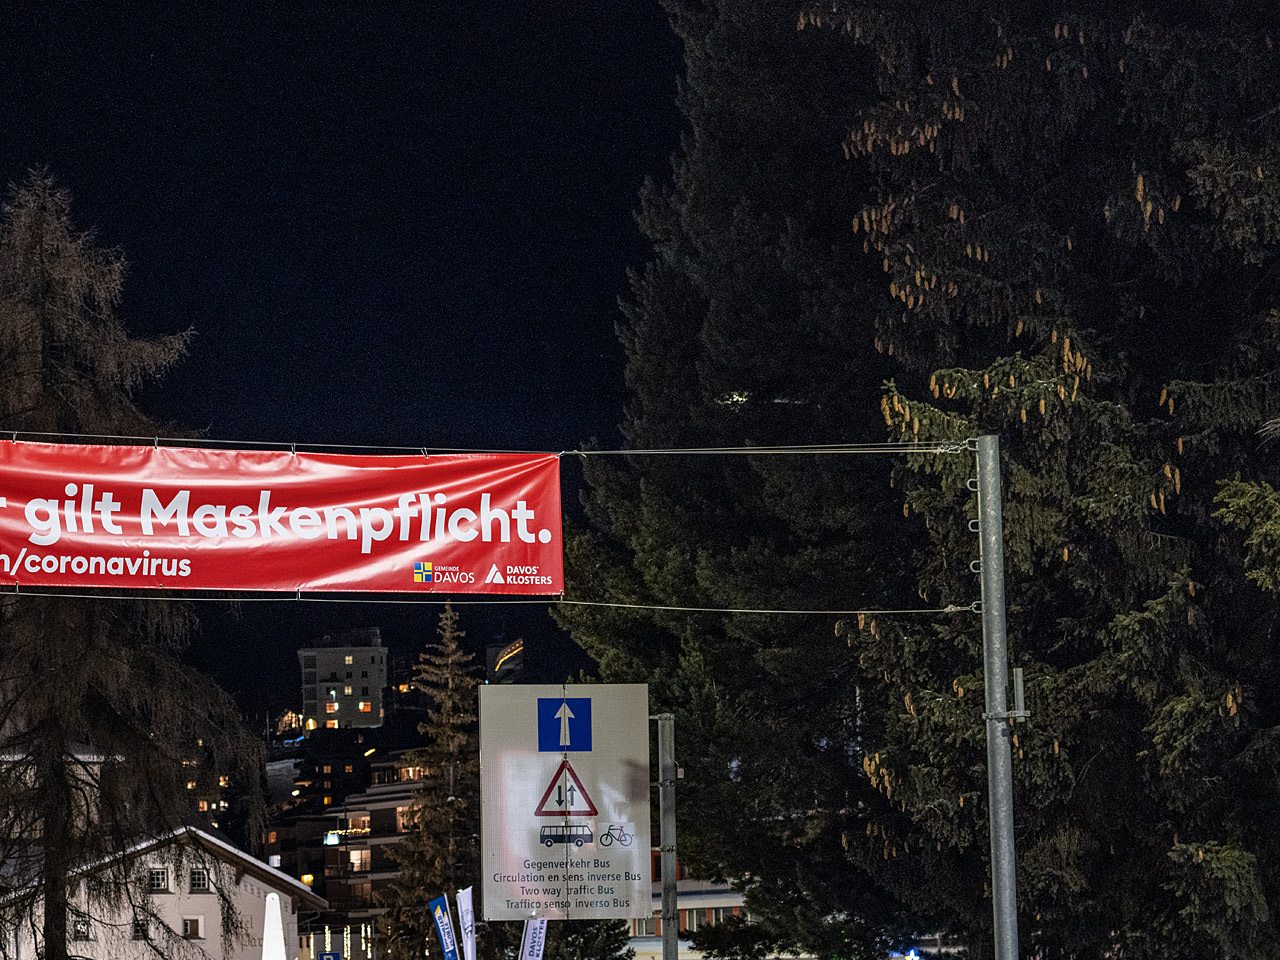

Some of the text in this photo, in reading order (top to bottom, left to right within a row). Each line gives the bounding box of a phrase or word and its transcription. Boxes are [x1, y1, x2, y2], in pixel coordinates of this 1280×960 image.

[24, 483, 122, 546] gilt
[140, 488, 551, 554] Maskenpflicht.
[506, 566, 538, 575] DAVOS
[434, 572, 475, 584] DAVOS
[506, 576, 552, 585] KLOSTERS
[523, 858, 610, 871] Gegenverkehr Bus
[493, 873, 545, 883] Circulation
[562, 874, 584, 882] sens
[587, 872, 621, 882] inverse
[624, 872, 642, 881] Bus
[520, 885, 614, 898] Two way traffic Bus
[506, 898, 630, 909] Traffico senso inverso Bus
[528, 926, 538, 957] DAVOS
[536, 920, 545, 958] KLOSTER
